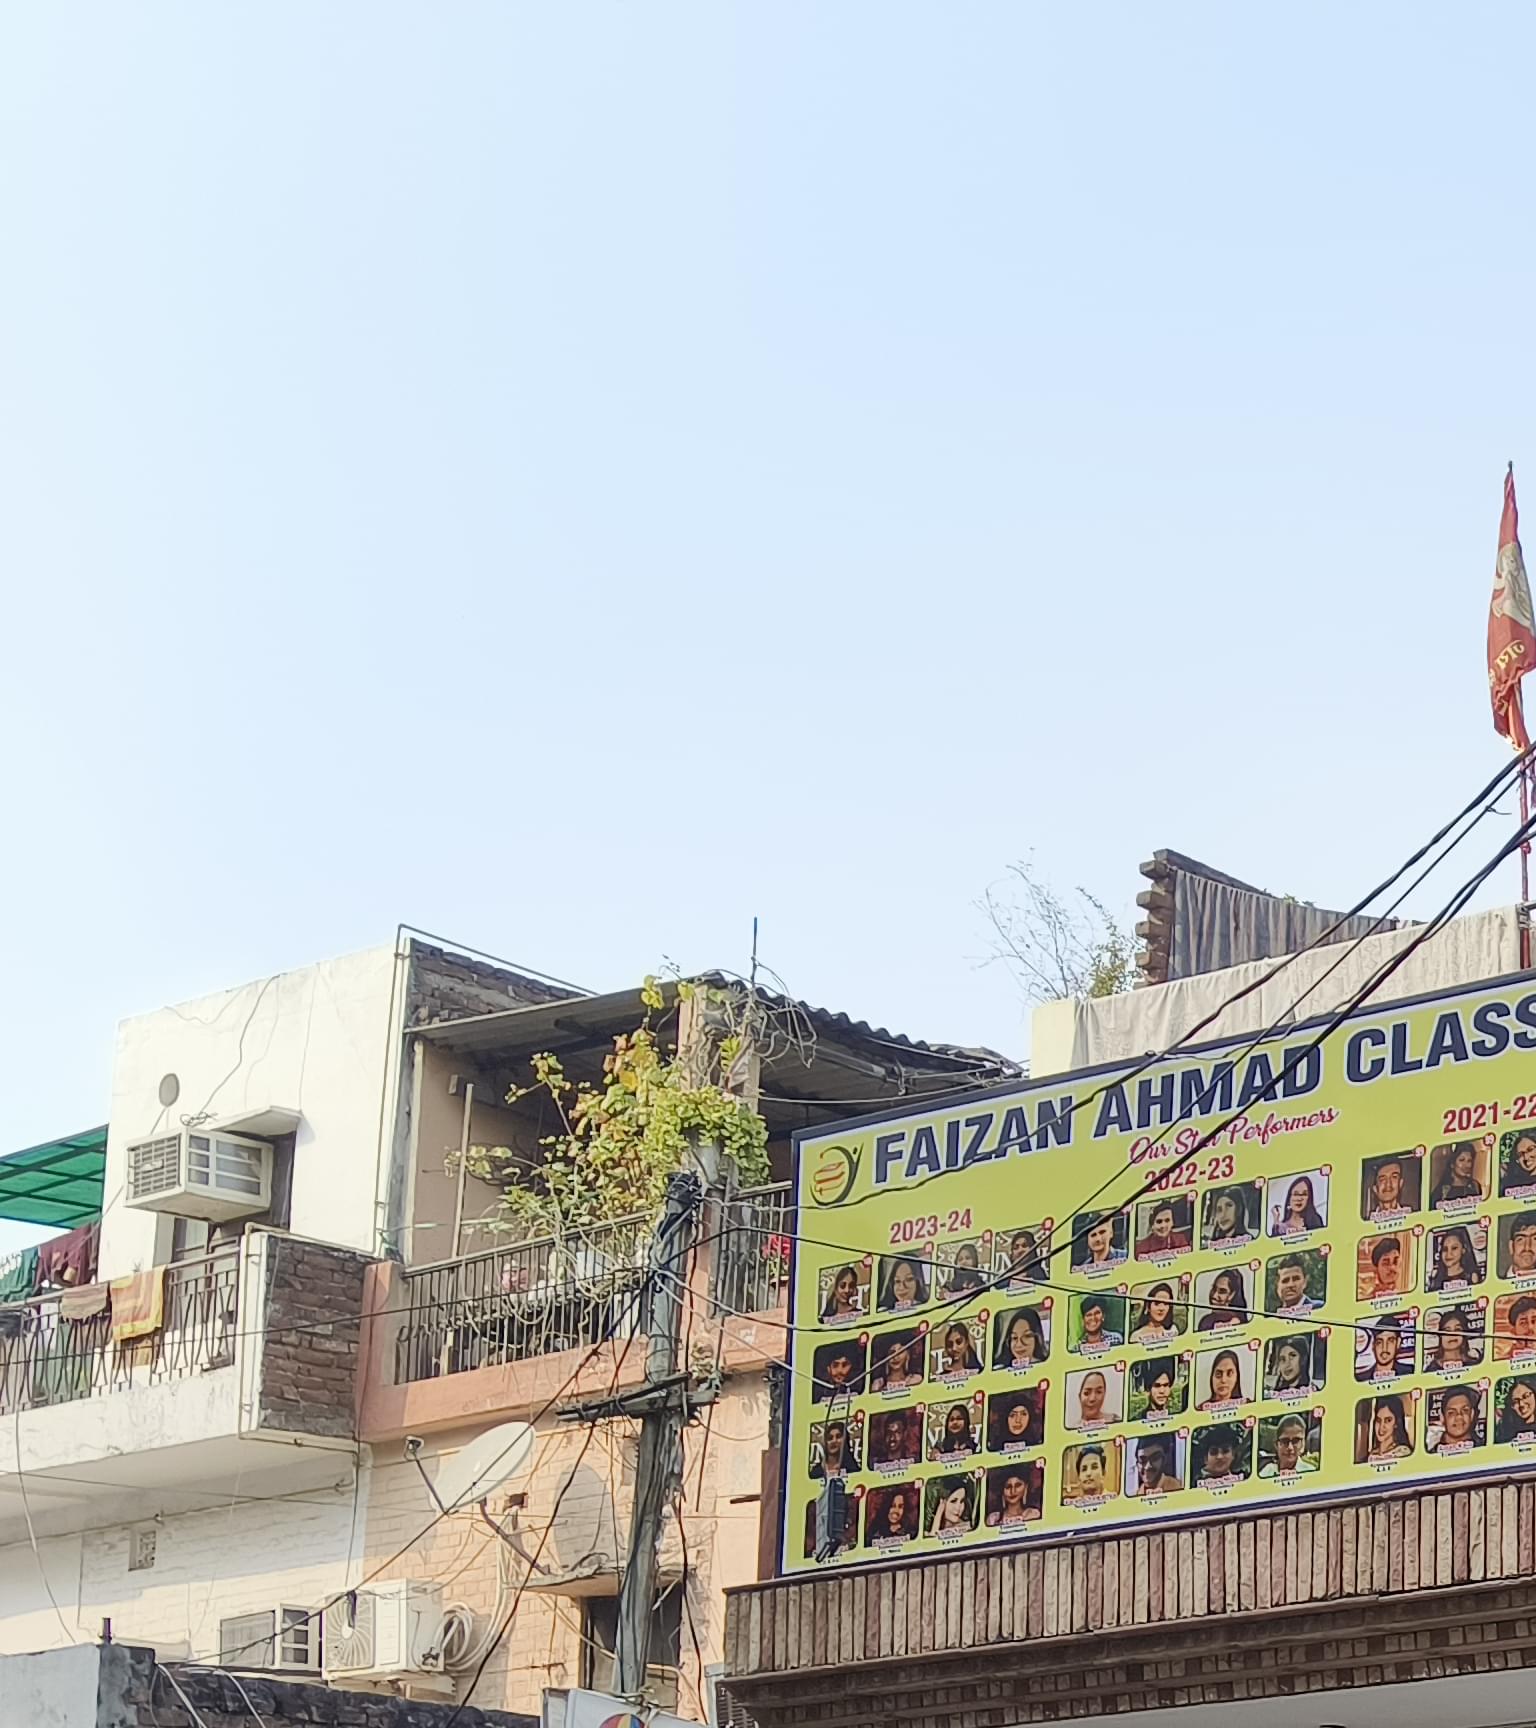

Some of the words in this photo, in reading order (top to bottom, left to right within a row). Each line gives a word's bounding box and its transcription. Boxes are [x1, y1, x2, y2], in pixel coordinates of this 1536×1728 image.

[874, 1096, 1074, 1185] FAIZAN
[1093, 1043, 1321, 1138] AHMAD
[1130, 1136, 1171, 1164] Our
[1225, 1108, 1339, 1145] Performers
[1144, 1155, 1234, 1192] 2022-23
[890, 1208, 972, 1244] 2023-24
